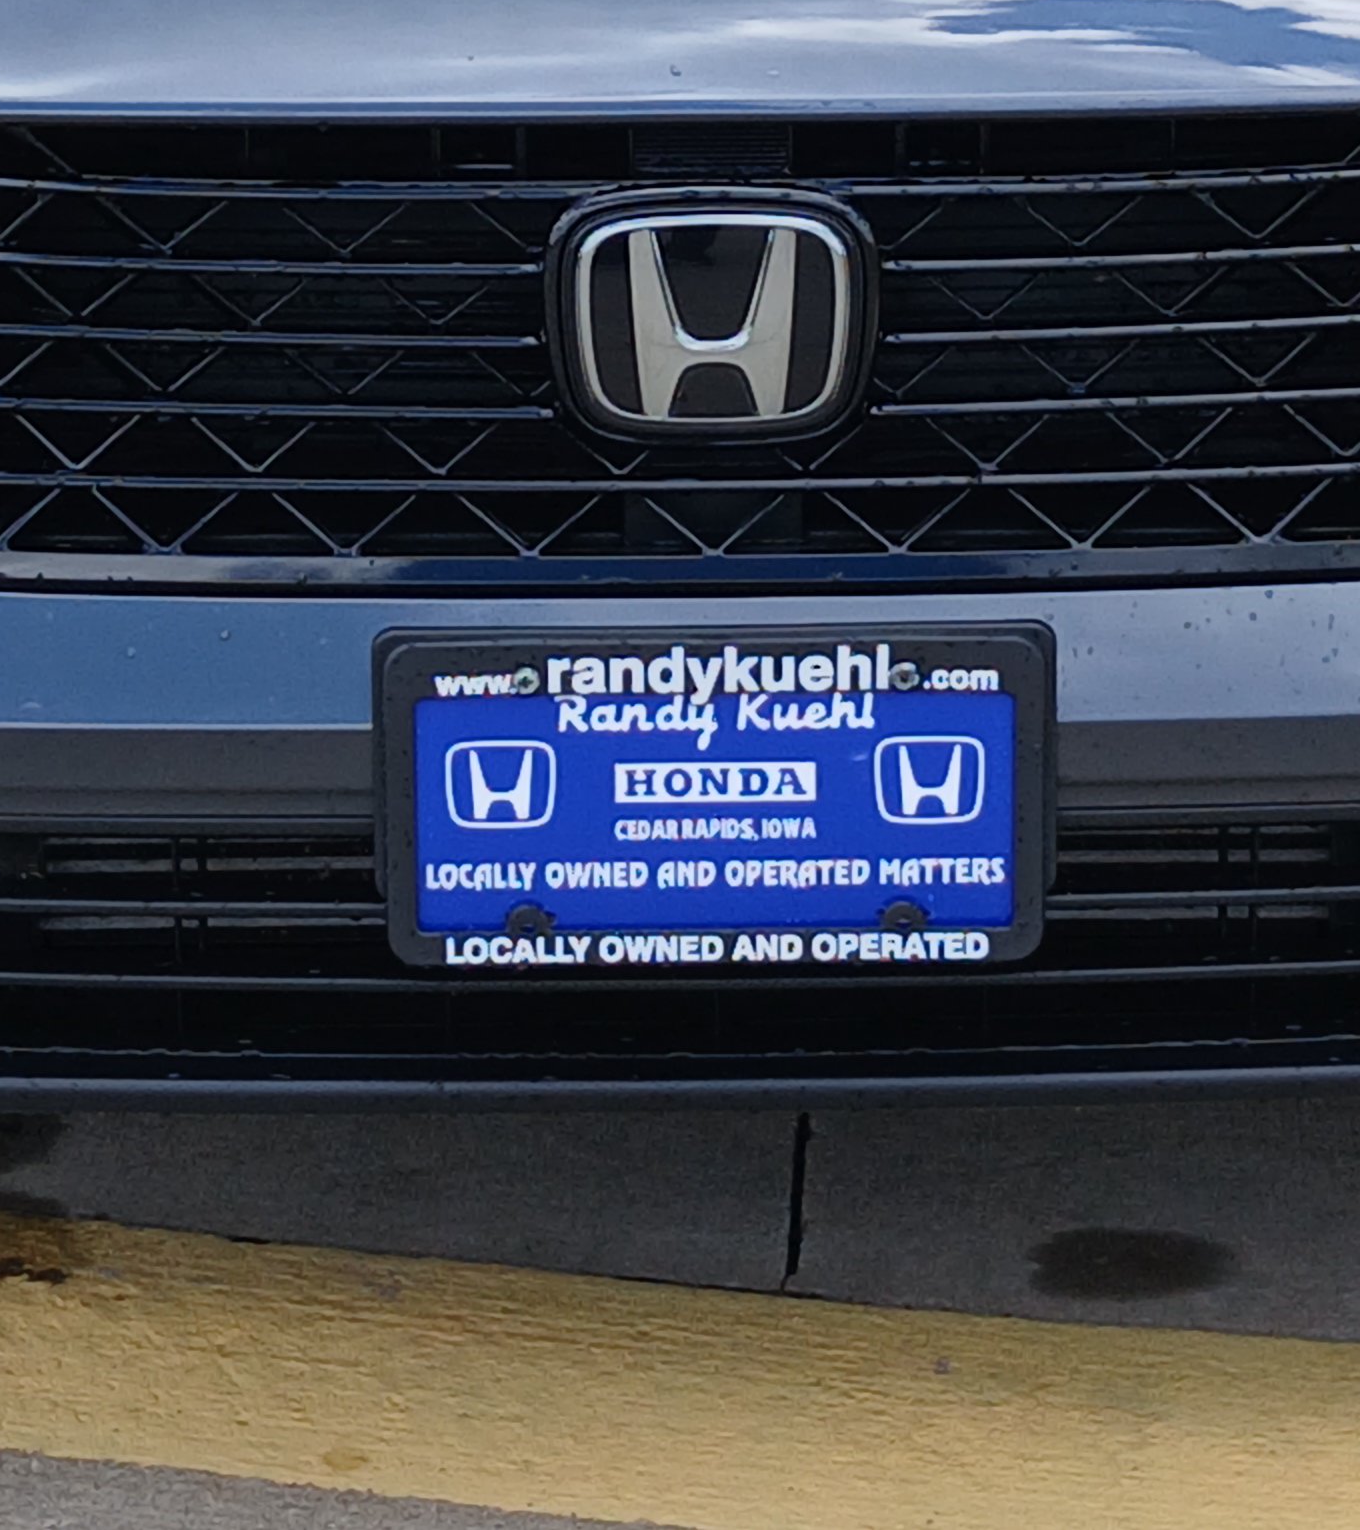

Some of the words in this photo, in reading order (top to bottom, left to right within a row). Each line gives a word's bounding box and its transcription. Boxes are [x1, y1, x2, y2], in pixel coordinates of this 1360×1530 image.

[554, 694, 719, 751] Randy
[736, 691, 875, 731] Kuehl
[624, 767, 808, 798] HONDA
[614, 819, 679, 841] CEDAR
[761, 817, 817, 839] IOWA
[425, 862, 536, 891] LOCALLY
[544, 861, 649, 890] OWNED
[656, 860, 717, 889] AND
[724, 859, 871, 888] OPERATED
[878, 857, 1006, 886] MATTERS
[445, 935, 592, 965] LOCALLY
[597, 934, 725, 963] OWNED
[731, 933, 803, 962] AND
[811, 931, 990, 961] OPERATED
